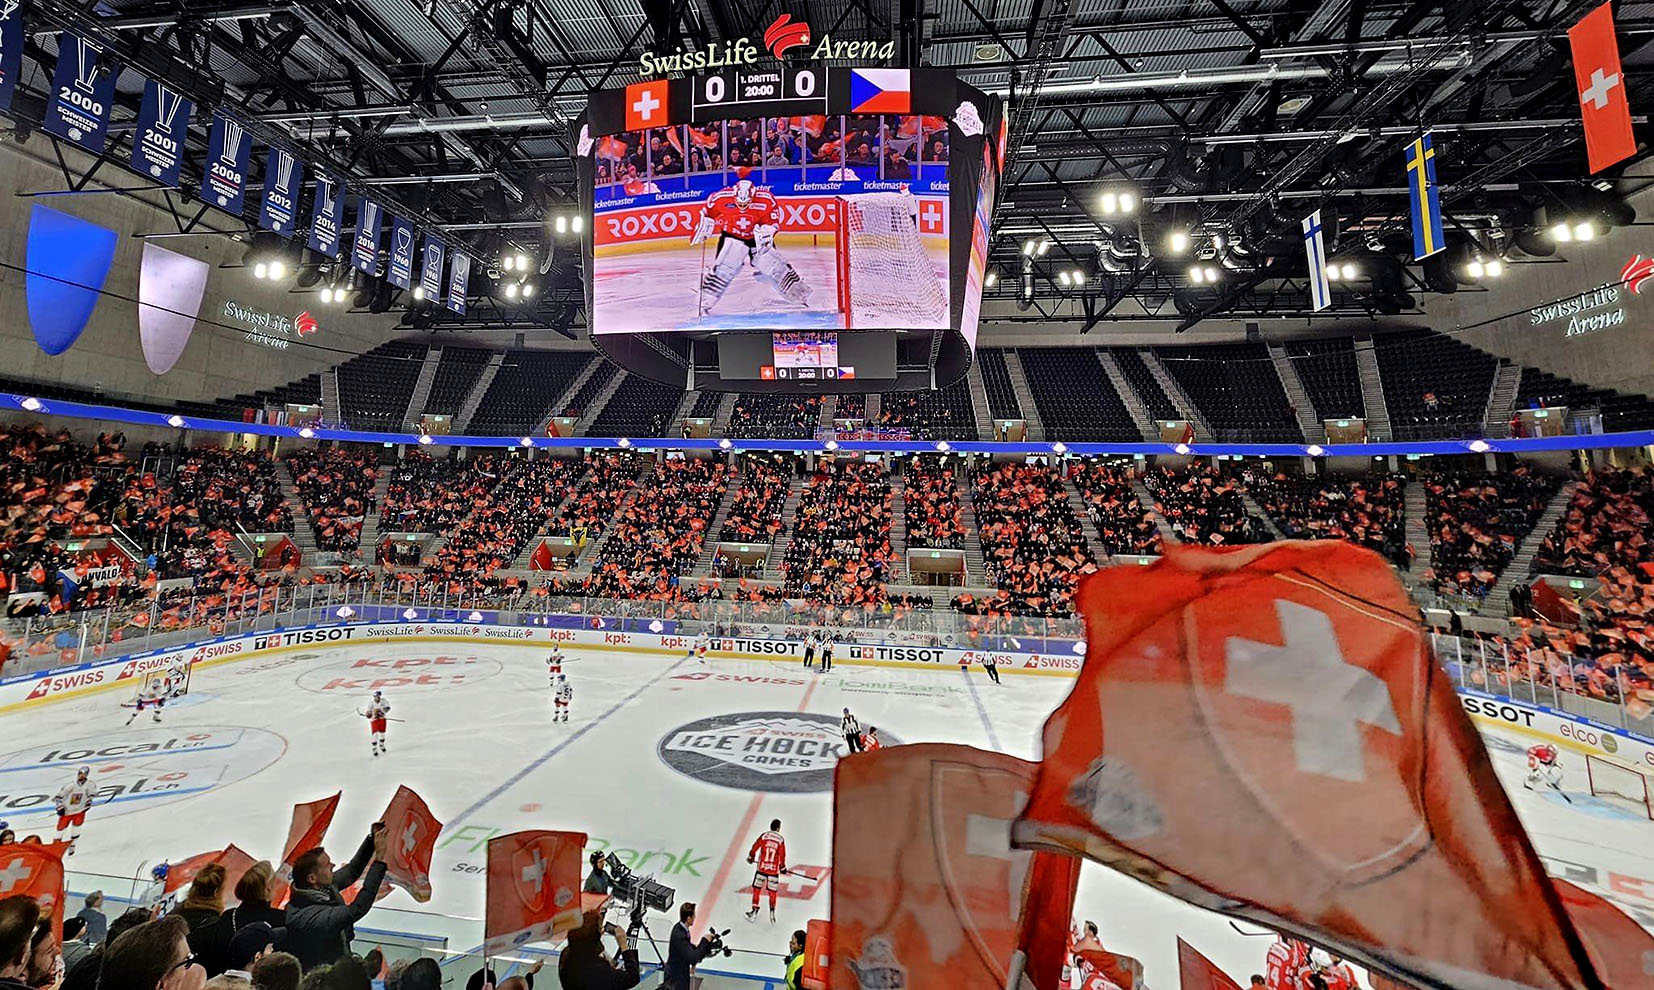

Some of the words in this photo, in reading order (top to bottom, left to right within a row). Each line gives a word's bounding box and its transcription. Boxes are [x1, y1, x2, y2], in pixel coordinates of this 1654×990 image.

[639, 38, 758, 76] SwissLife
[811, 33, 896, 60] Arena
[740, 76, 747, 84] 1.
[748, 74, 781, 84] DRITTEL
[795, 71, 816, 97] 0
[705, 76, 725, 102] 0
[744, 85, 774, 97] 20:00
[58, 86, 103, 116] 2000
[56, 106, 99, 131] SCHWEIZER
[61, 115, 92, 133] MEISTER
[143, 128, 177, 153] 2001
[141, 145, 175, 167] SCHWEIZER
[144, 154, 171, 170] MEISTER
[211, 162, 241, 184] 2008
[209, 178, 239, 196] SCHWEIZER
[213, 186, 234, 199] MEISTER
[793, 181, 842, 192] ticketmaster
[268, 191, 292, 210] 2012
[655, 189, 702, 201] ticketmaster
[316, 215, 336, 233] 2014
[607, 210, 693, 238] ROXOR
[357, 235, 375, 250] 2018
[393, 253, 409, 267] 1960
[1530, 282, 1618, 326] SwissLife
[224, 300, 291, 334] SwissLife
[1564, 307, 1625, 338] Arena
[246, 326, 289, 349] Arena
[779, 368, 787, 378] 0
[826, 368, 835, 378] 0
[284, 628, 356, 646] TISSOT
[367, 626, 413, 637] SwissLife
[430, 626, 471, 636] SwissLife
[485, 628, 524, 639] SwissLife
[550, 629, 576, 642] kpt:
[605, 632, 631, 645] kpt:
[206, 642, 242, 658] SWISS
[661, 636, 688, 649] kpt:
[735, 640, 799, 655] TISSOT
[351, 656, 478, 669] kpt:
[876, 647, 944, 663] TISSOT
[975, 655, 1013, 665] SISS
[1041, 657, 1080, 669] SWISS
[53, 670, 104, 692] SWISS
[321, 674, 465, 690] kpt:
[716, 673, 805, 686] SWISS
[1559, 723, 1598, 746] elco
[679, 734, 740, 751] ICE
[743, 735, 844, 760] HOCK
[743, 755, 812, 768] GAMES
[764, 847, 776, 862] 17
